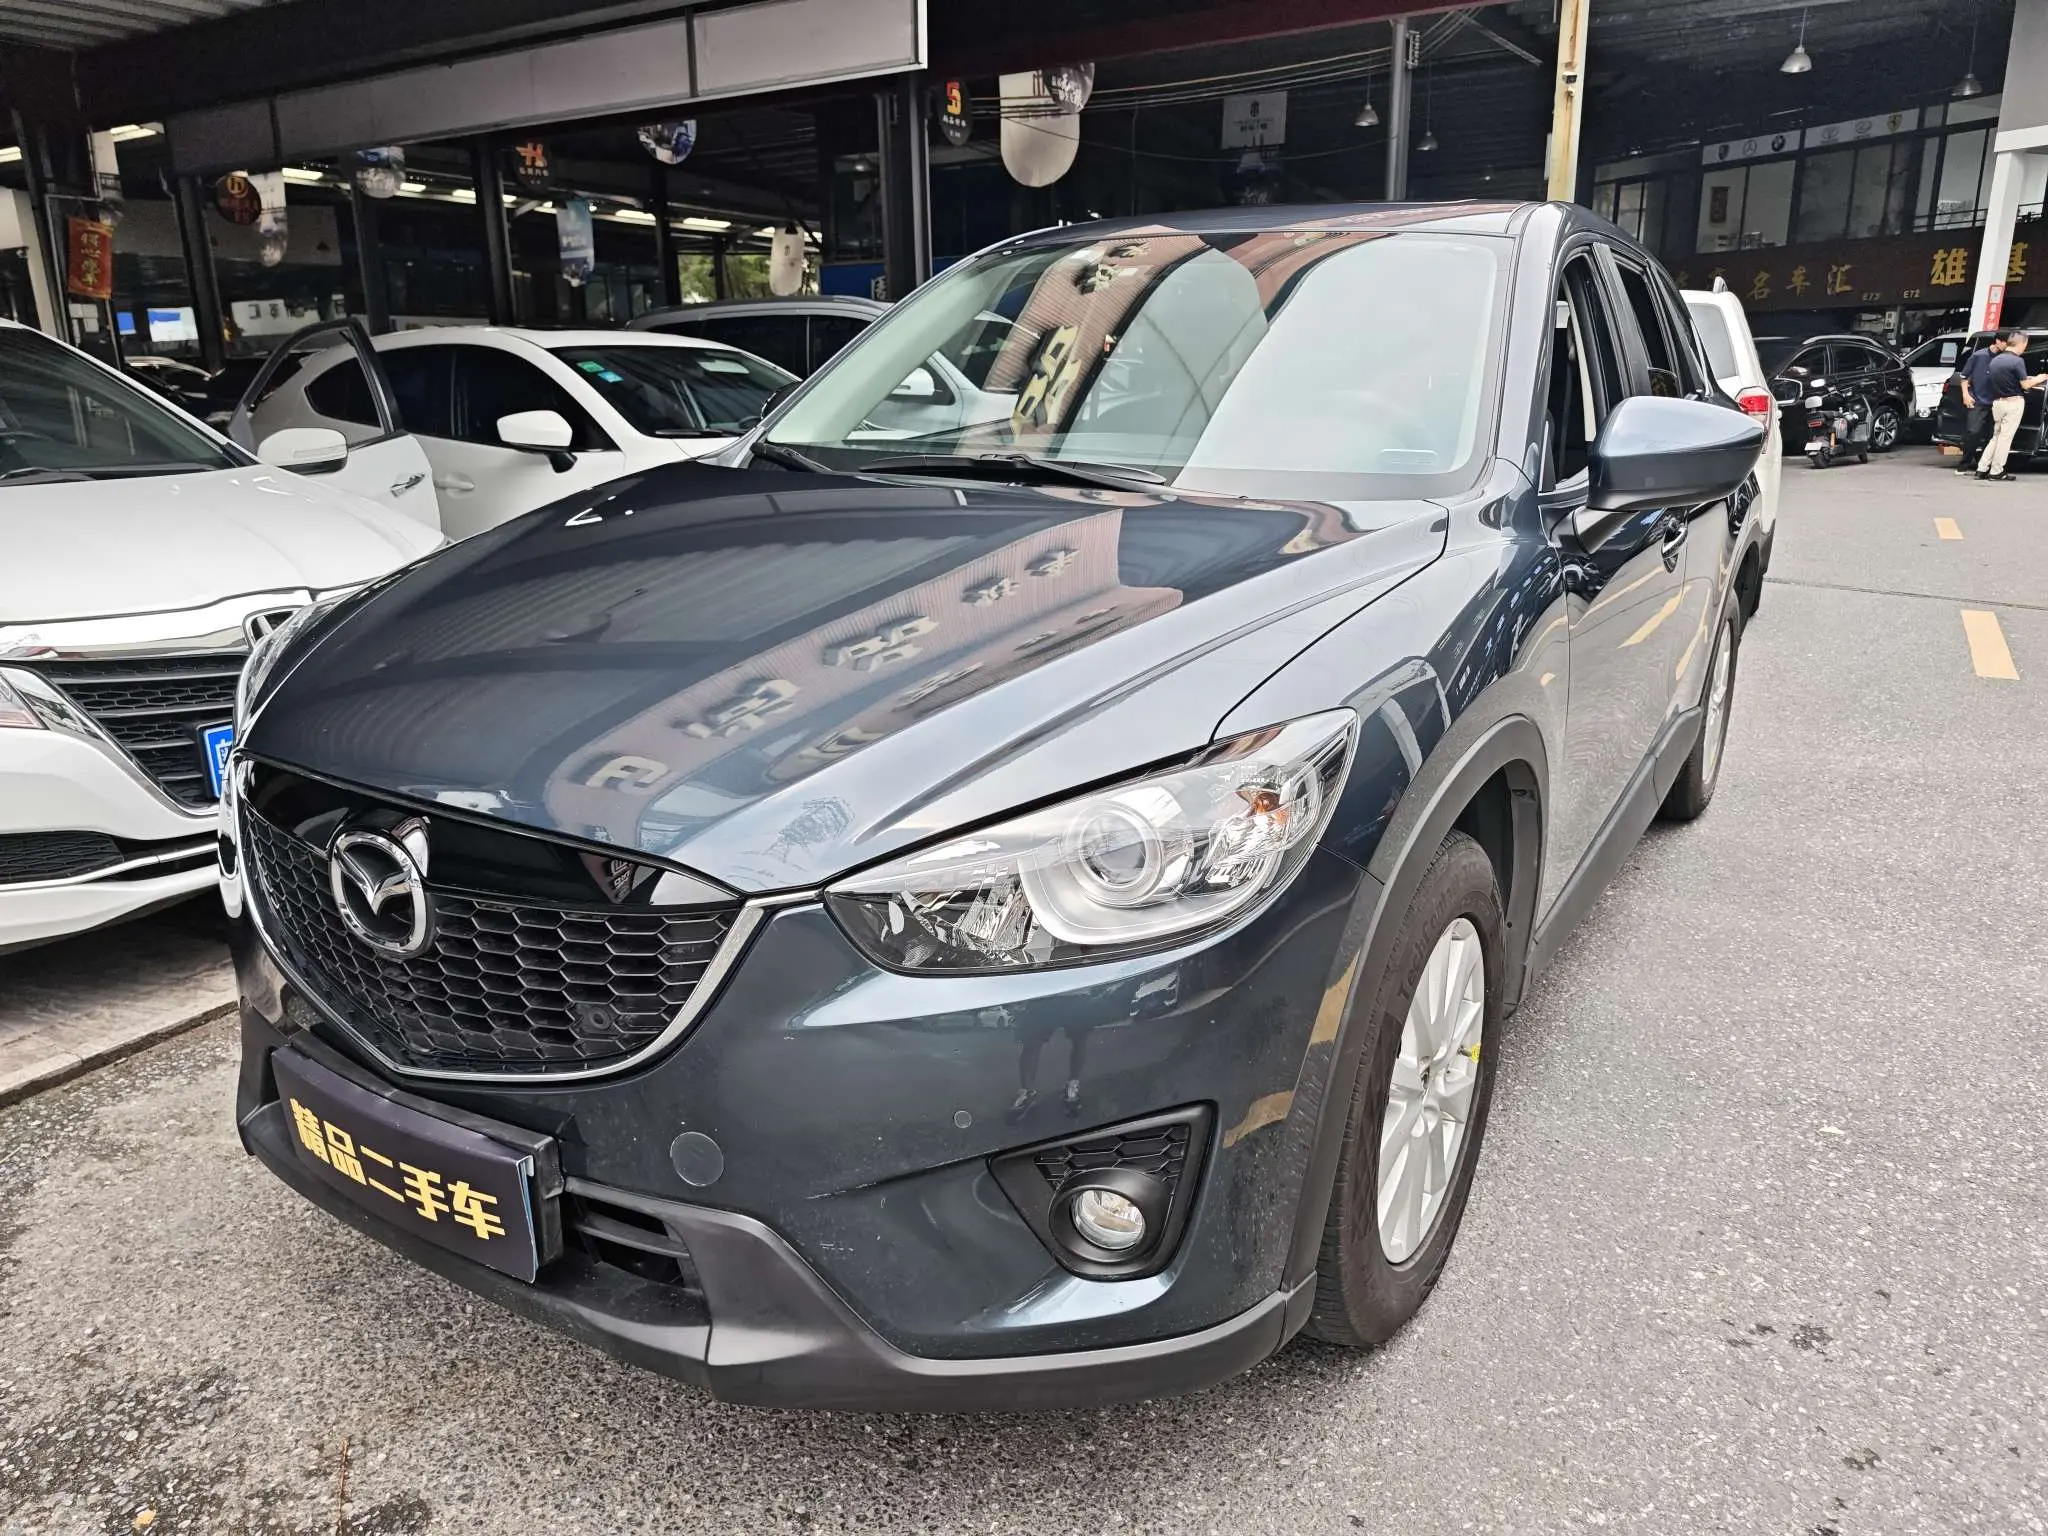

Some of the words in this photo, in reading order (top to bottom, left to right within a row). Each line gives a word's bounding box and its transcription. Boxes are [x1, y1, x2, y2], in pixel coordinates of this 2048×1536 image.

[290, 1098, 506, 1241] 精品二手车
